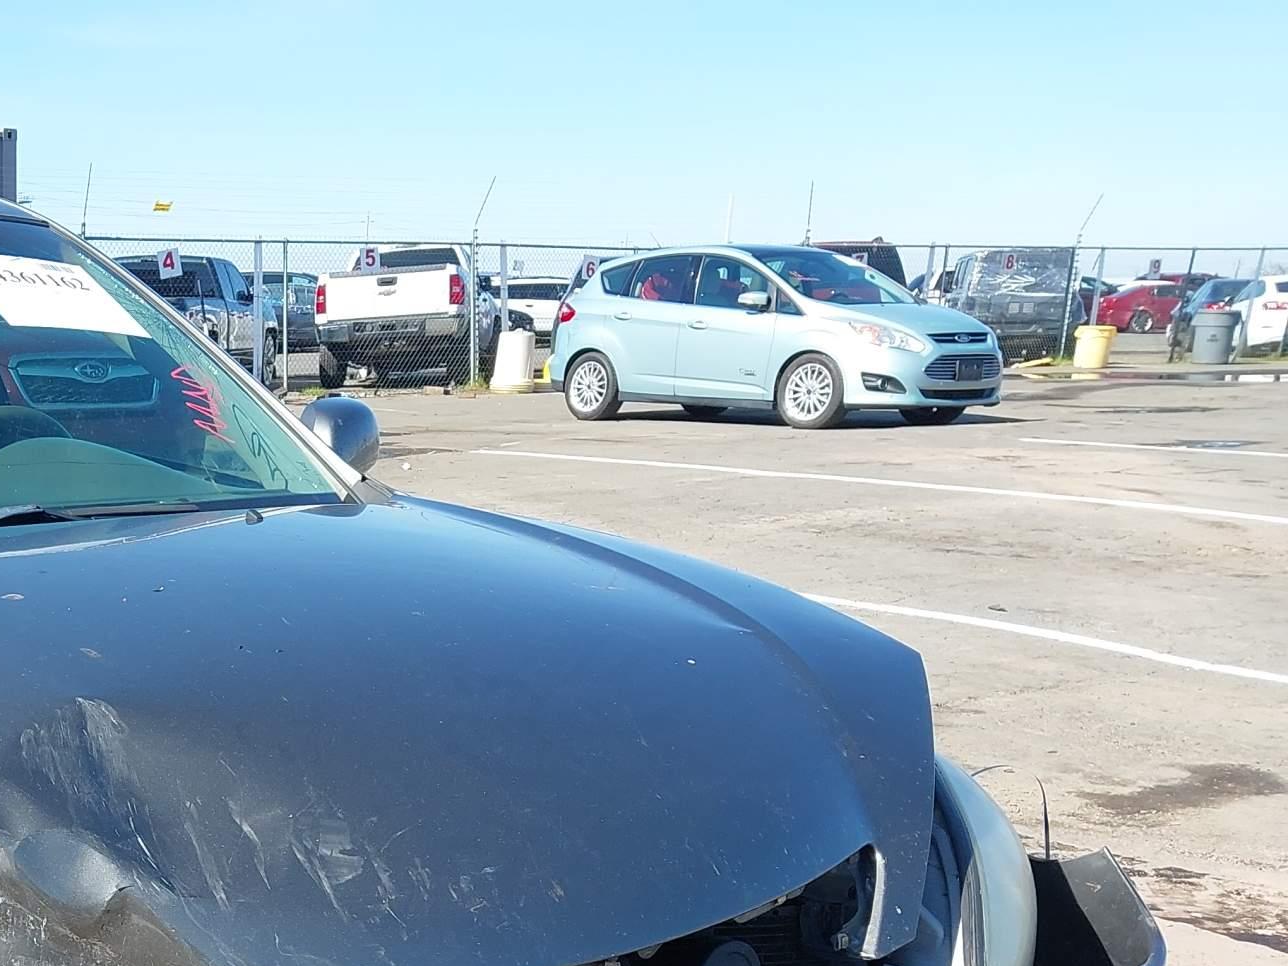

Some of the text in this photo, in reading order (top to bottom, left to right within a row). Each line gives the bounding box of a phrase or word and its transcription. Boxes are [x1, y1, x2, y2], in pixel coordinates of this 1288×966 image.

[162, 251, 175, 270] 4
[365, 249, 376, 267] 5
[1006, 254, 1015, 270] 8
[1153, 259, 1161, 274] 9
[586, 261, 596, 279] 6
